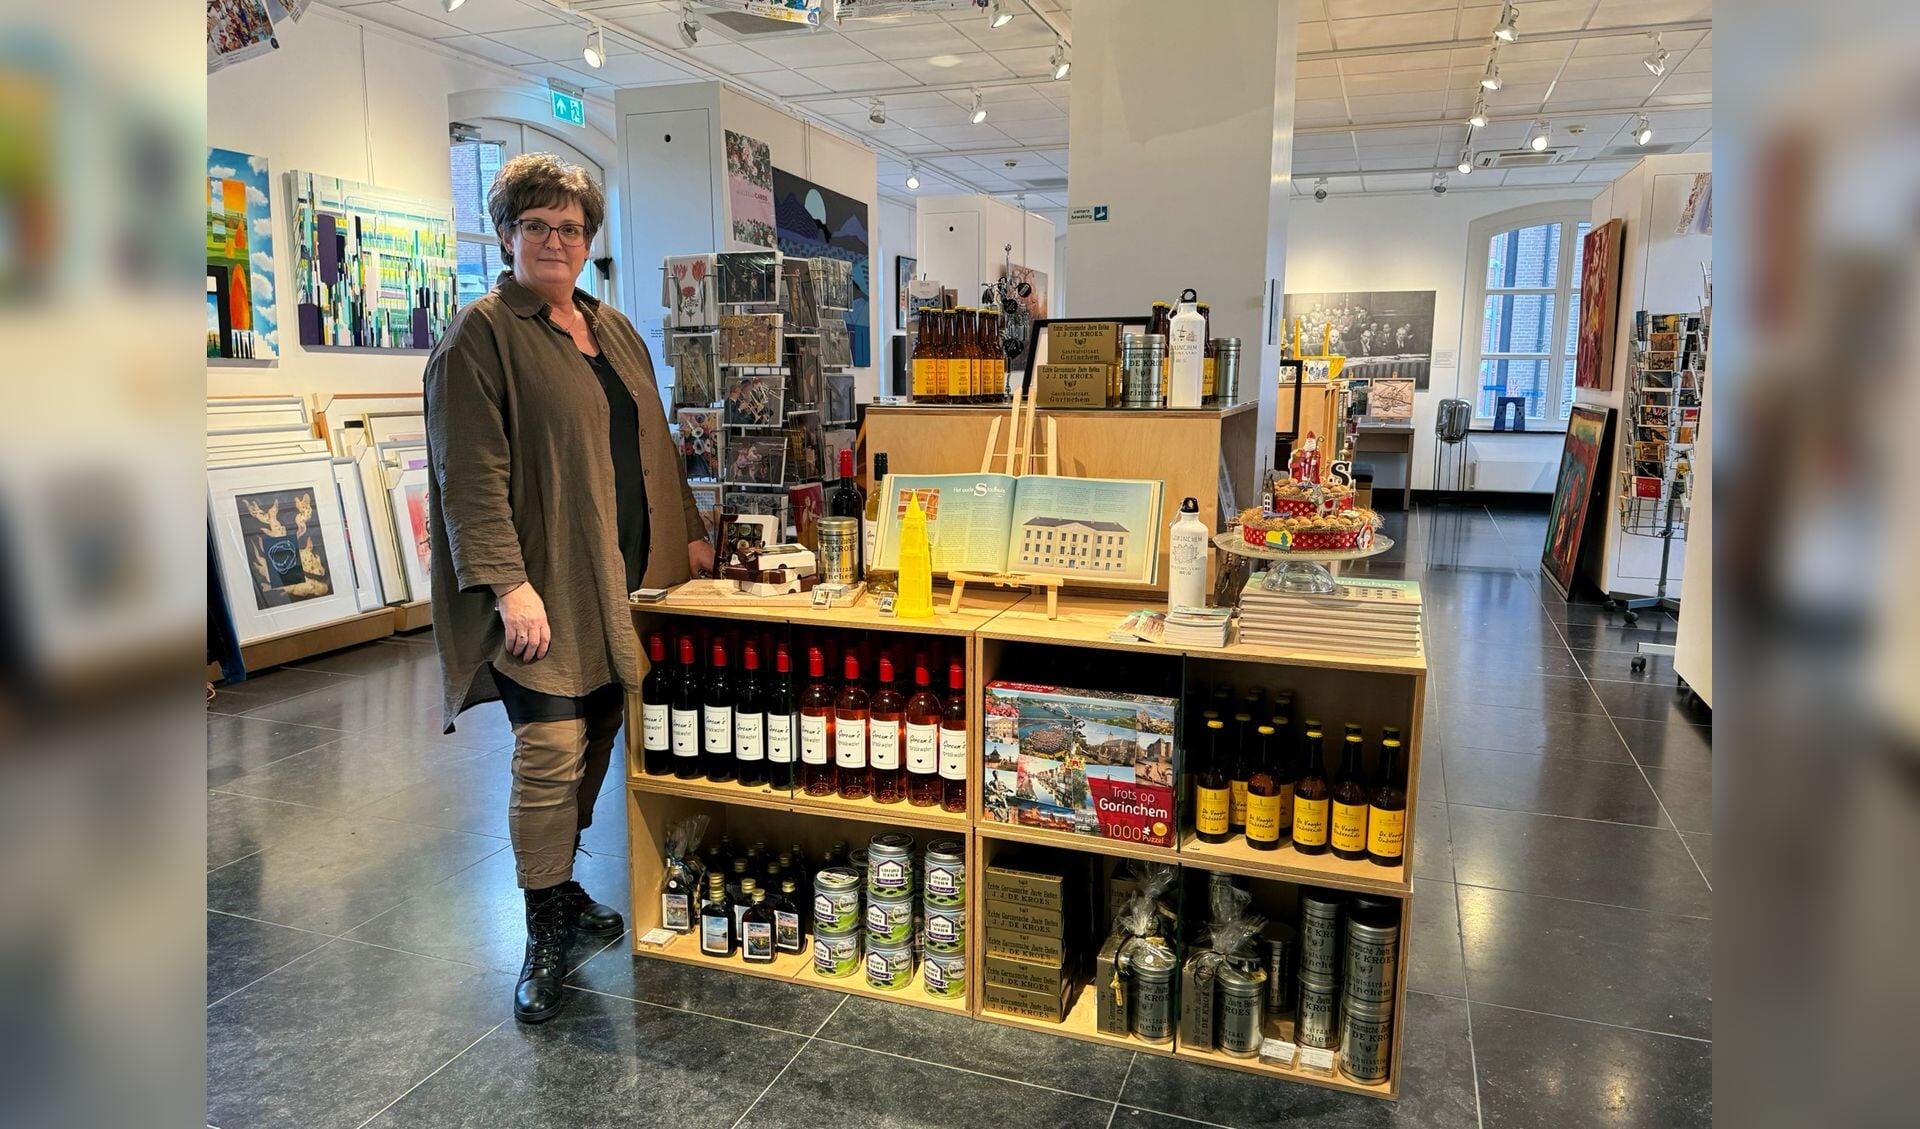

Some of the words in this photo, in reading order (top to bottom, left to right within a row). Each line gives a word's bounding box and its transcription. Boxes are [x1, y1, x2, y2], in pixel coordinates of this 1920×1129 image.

[1112, 786, 1137, 801] Trots
[1140, 793, 1155, 804] op
[1100, 798, 1168, 819] Gorinchem
[1107, 824, 1141, 841] 1000
[1142, 834, 1164, 844] Puzzel
[1022, 895, 1050, 906] KROES
[1022, 923, 1051, 934] KROES
[1010, 948, 1020, 956] DE
[1022, 950, 1051, 961] KROES
[1008, 978, 1019, 986] DE
[1020, 980, 1049, 992] KROES
[1020, 1008, 1049, 1019] KROES
[1352, 1030, 1366, 1041] DE
